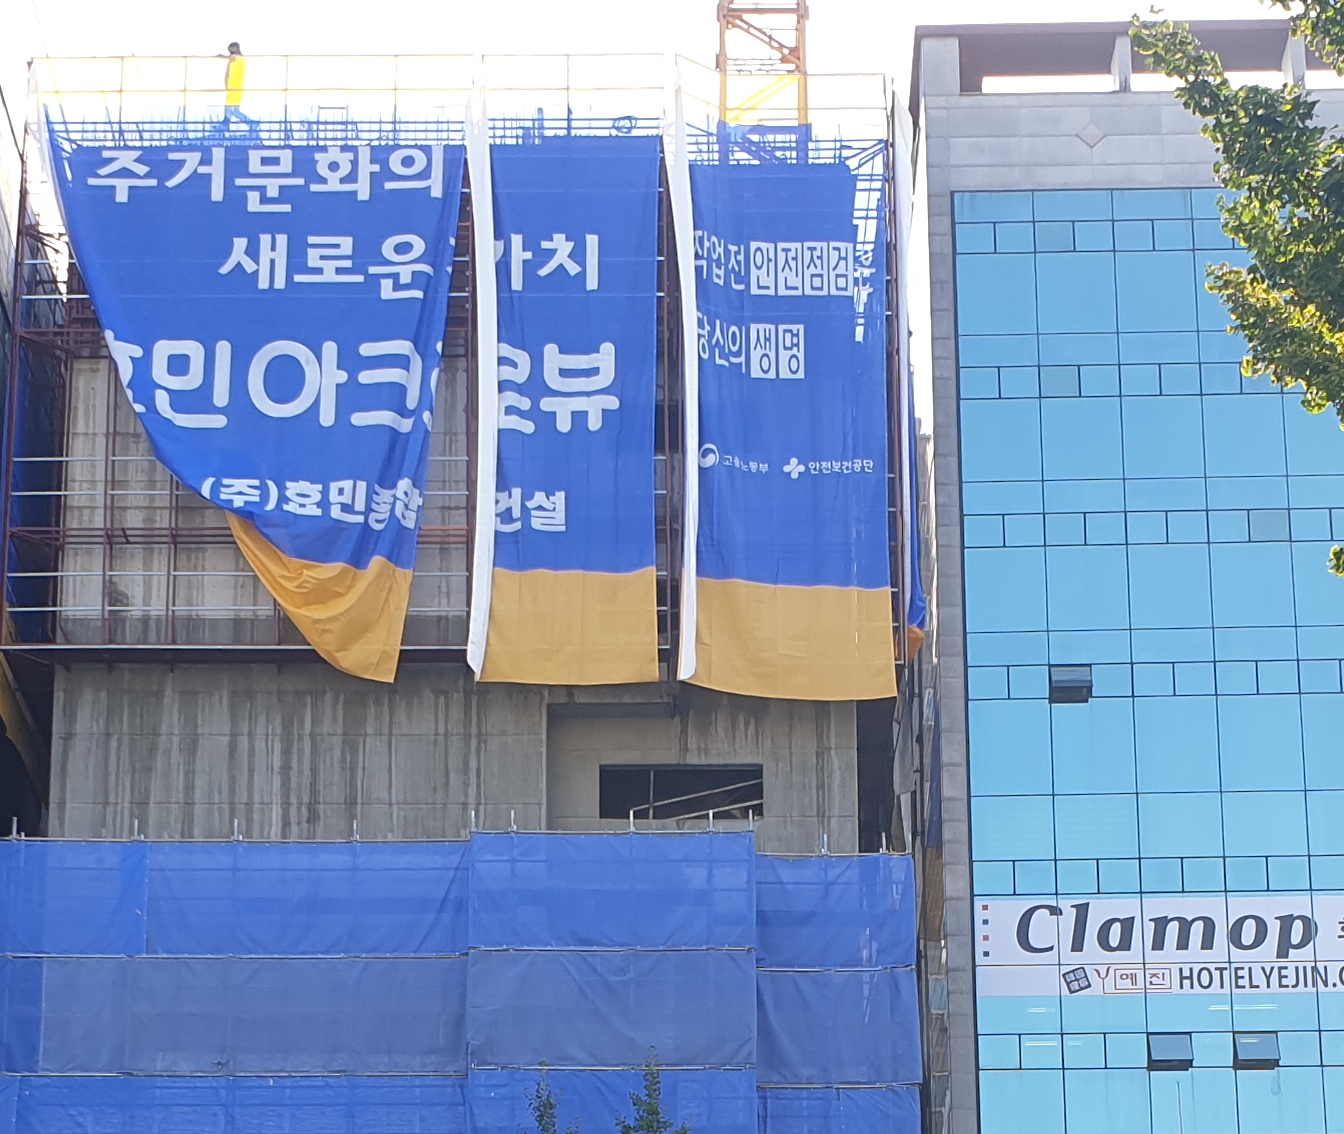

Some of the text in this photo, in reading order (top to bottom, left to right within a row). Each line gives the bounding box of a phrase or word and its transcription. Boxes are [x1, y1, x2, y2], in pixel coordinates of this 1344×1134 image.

[87, 145, 446, 213] 주거문화의
[217, 233, 435, 300] 새로운
[751, 242, 854, 296] 안전점검
[750, 323, 805, 379] 생명
[808, 458, 874, 474] 안전보건공단
[1015, 901, 1319, 960] Clamop
